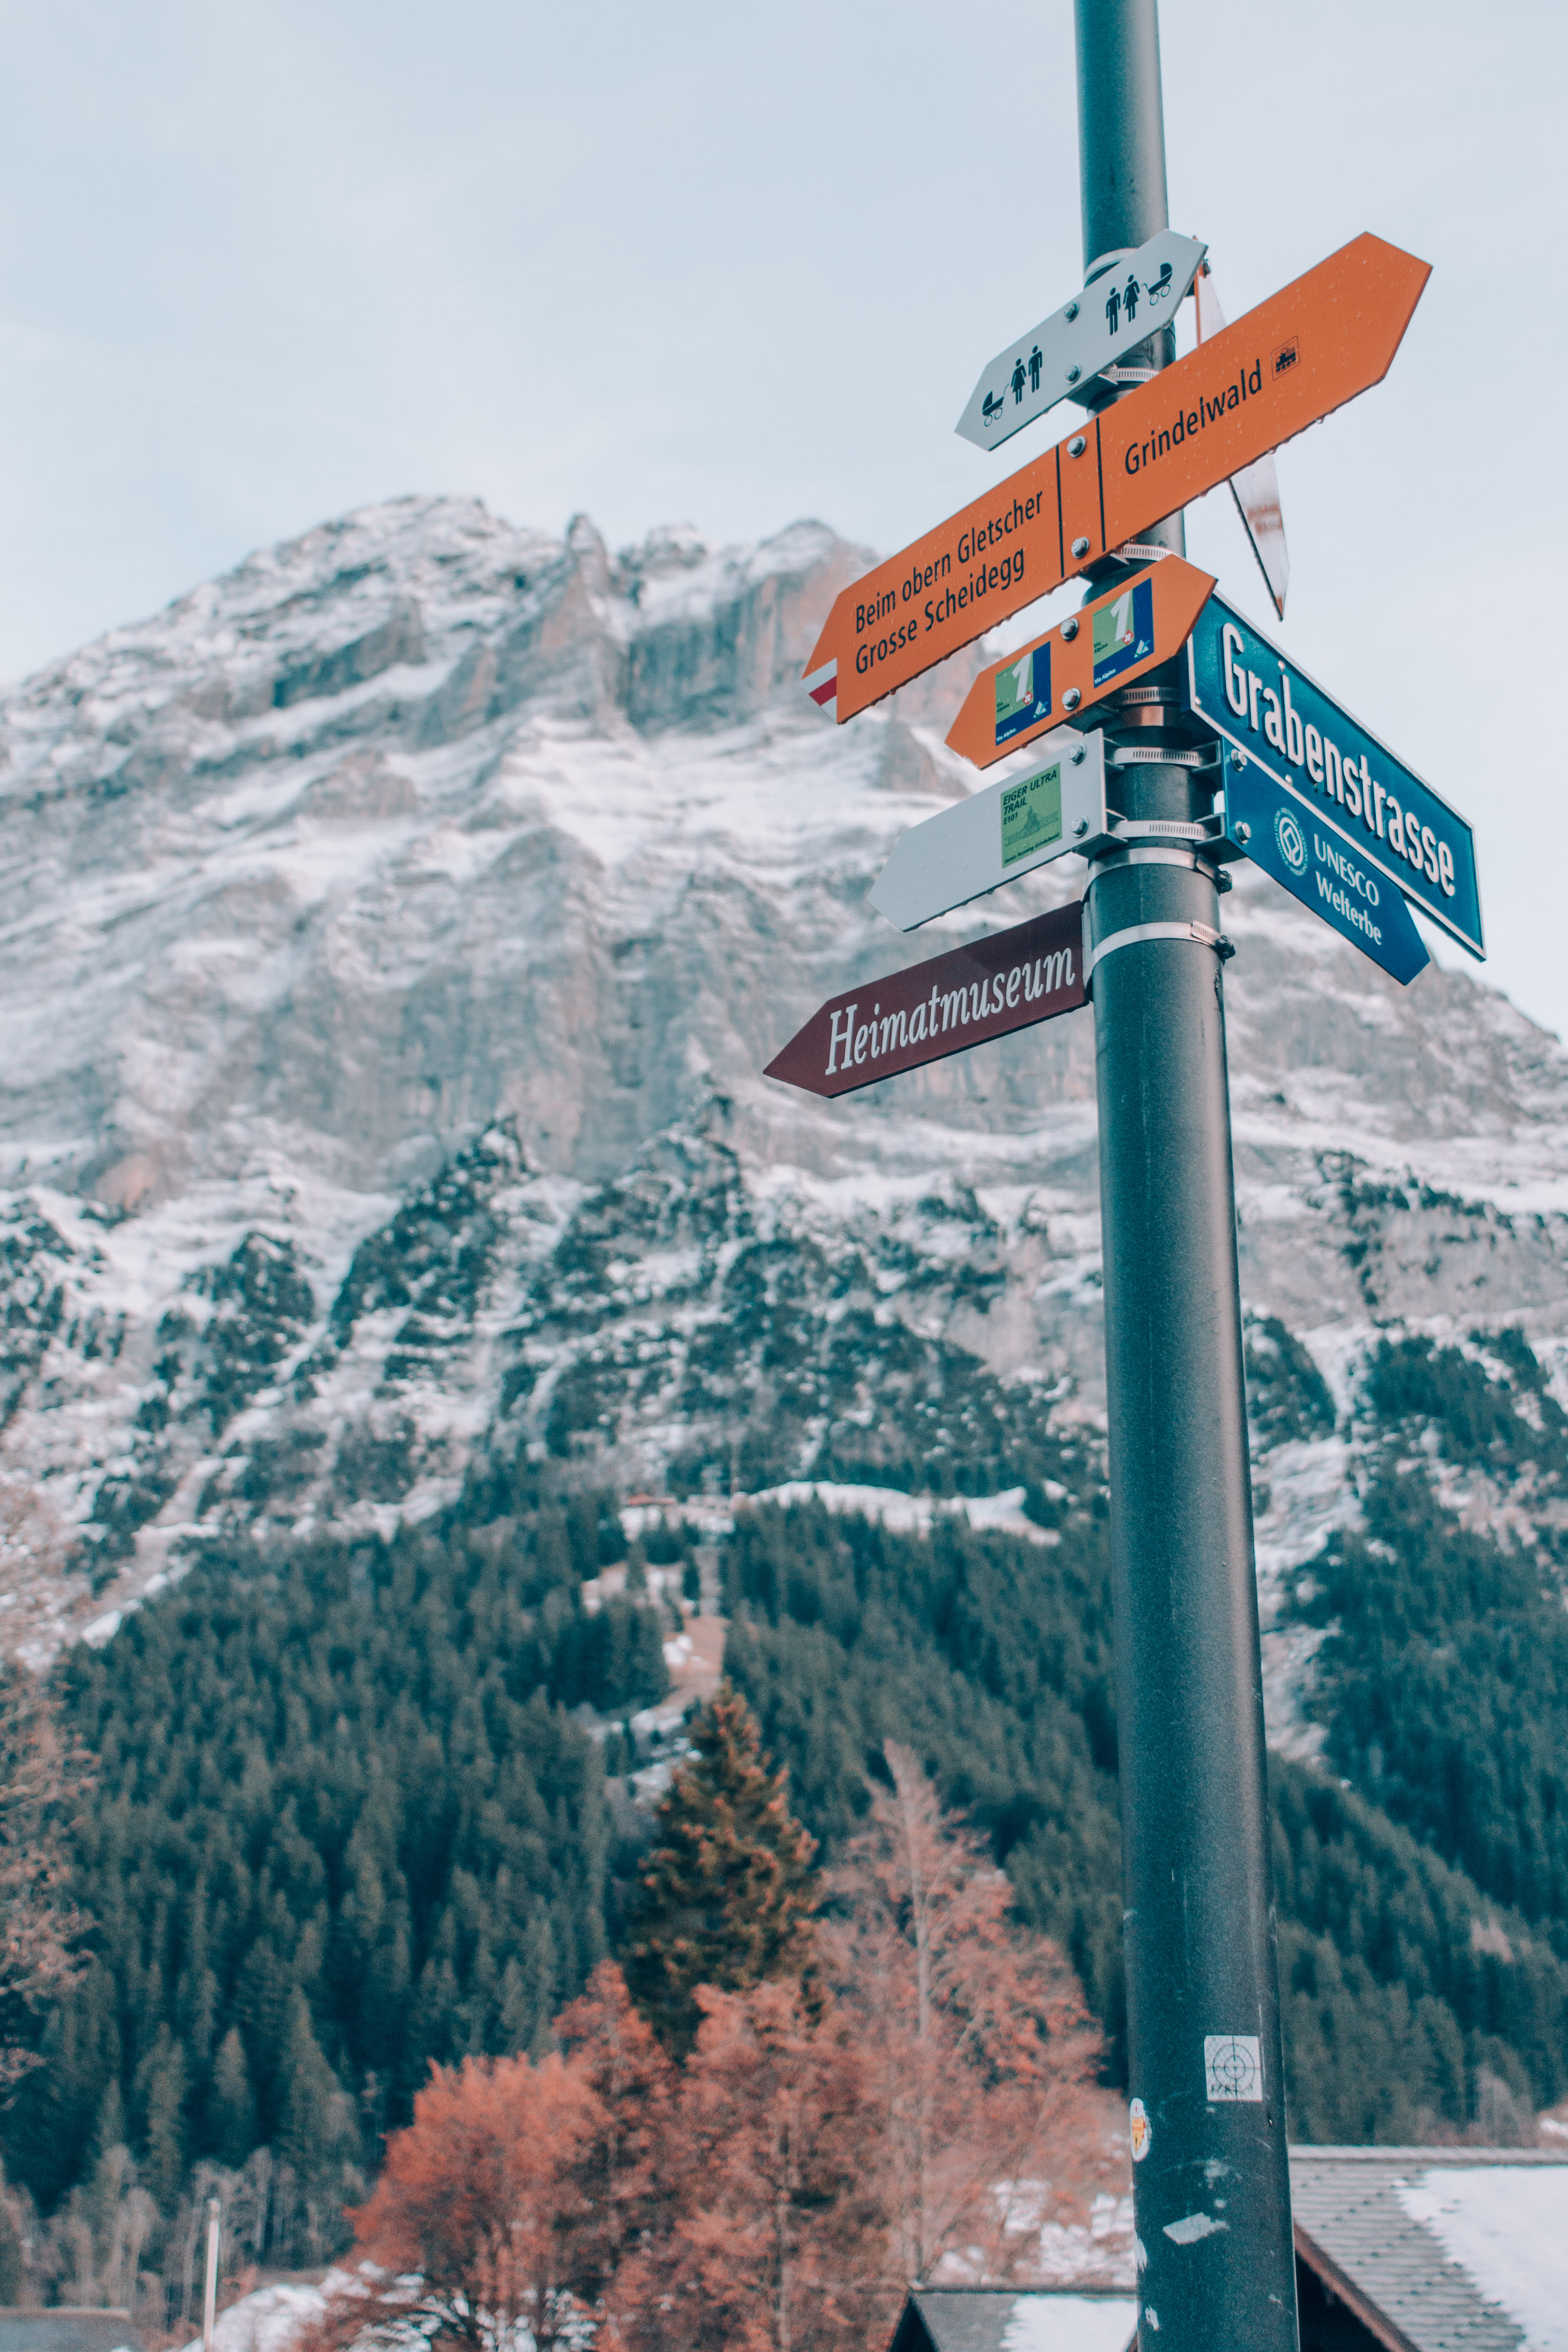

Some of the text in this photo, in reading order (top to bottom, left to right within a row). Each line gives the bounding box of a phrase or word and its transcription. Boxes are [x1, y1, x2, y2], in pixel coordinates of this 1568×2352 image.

[1125, 359, 1262, 475] Grindelwald
[856, 490, 1042, 634] Beim obern Gletscher
[856, 548, 1024, 674] Grosse Scheidegg
[1110, 590, 1131, 642] 1
[1011, 652, 1031, 702] 1
[1102, 669, 1116, 679] Alpina
[1004, 728, 1017, 738] Alpina
[1222, 623, 1456, 898] Grabenstrasse
[1004, 770, 1057, 806] EIGER ULTRA
[1004, 797, 1027, 815] TRAIL
[1004, 812, 1018, 825] E101
[1314, 834, 1379, 906] UNESCO
[1315, 871, 1382, 945] Welterbe
[825, 947, 1075, 1075] Heimatmuseum
